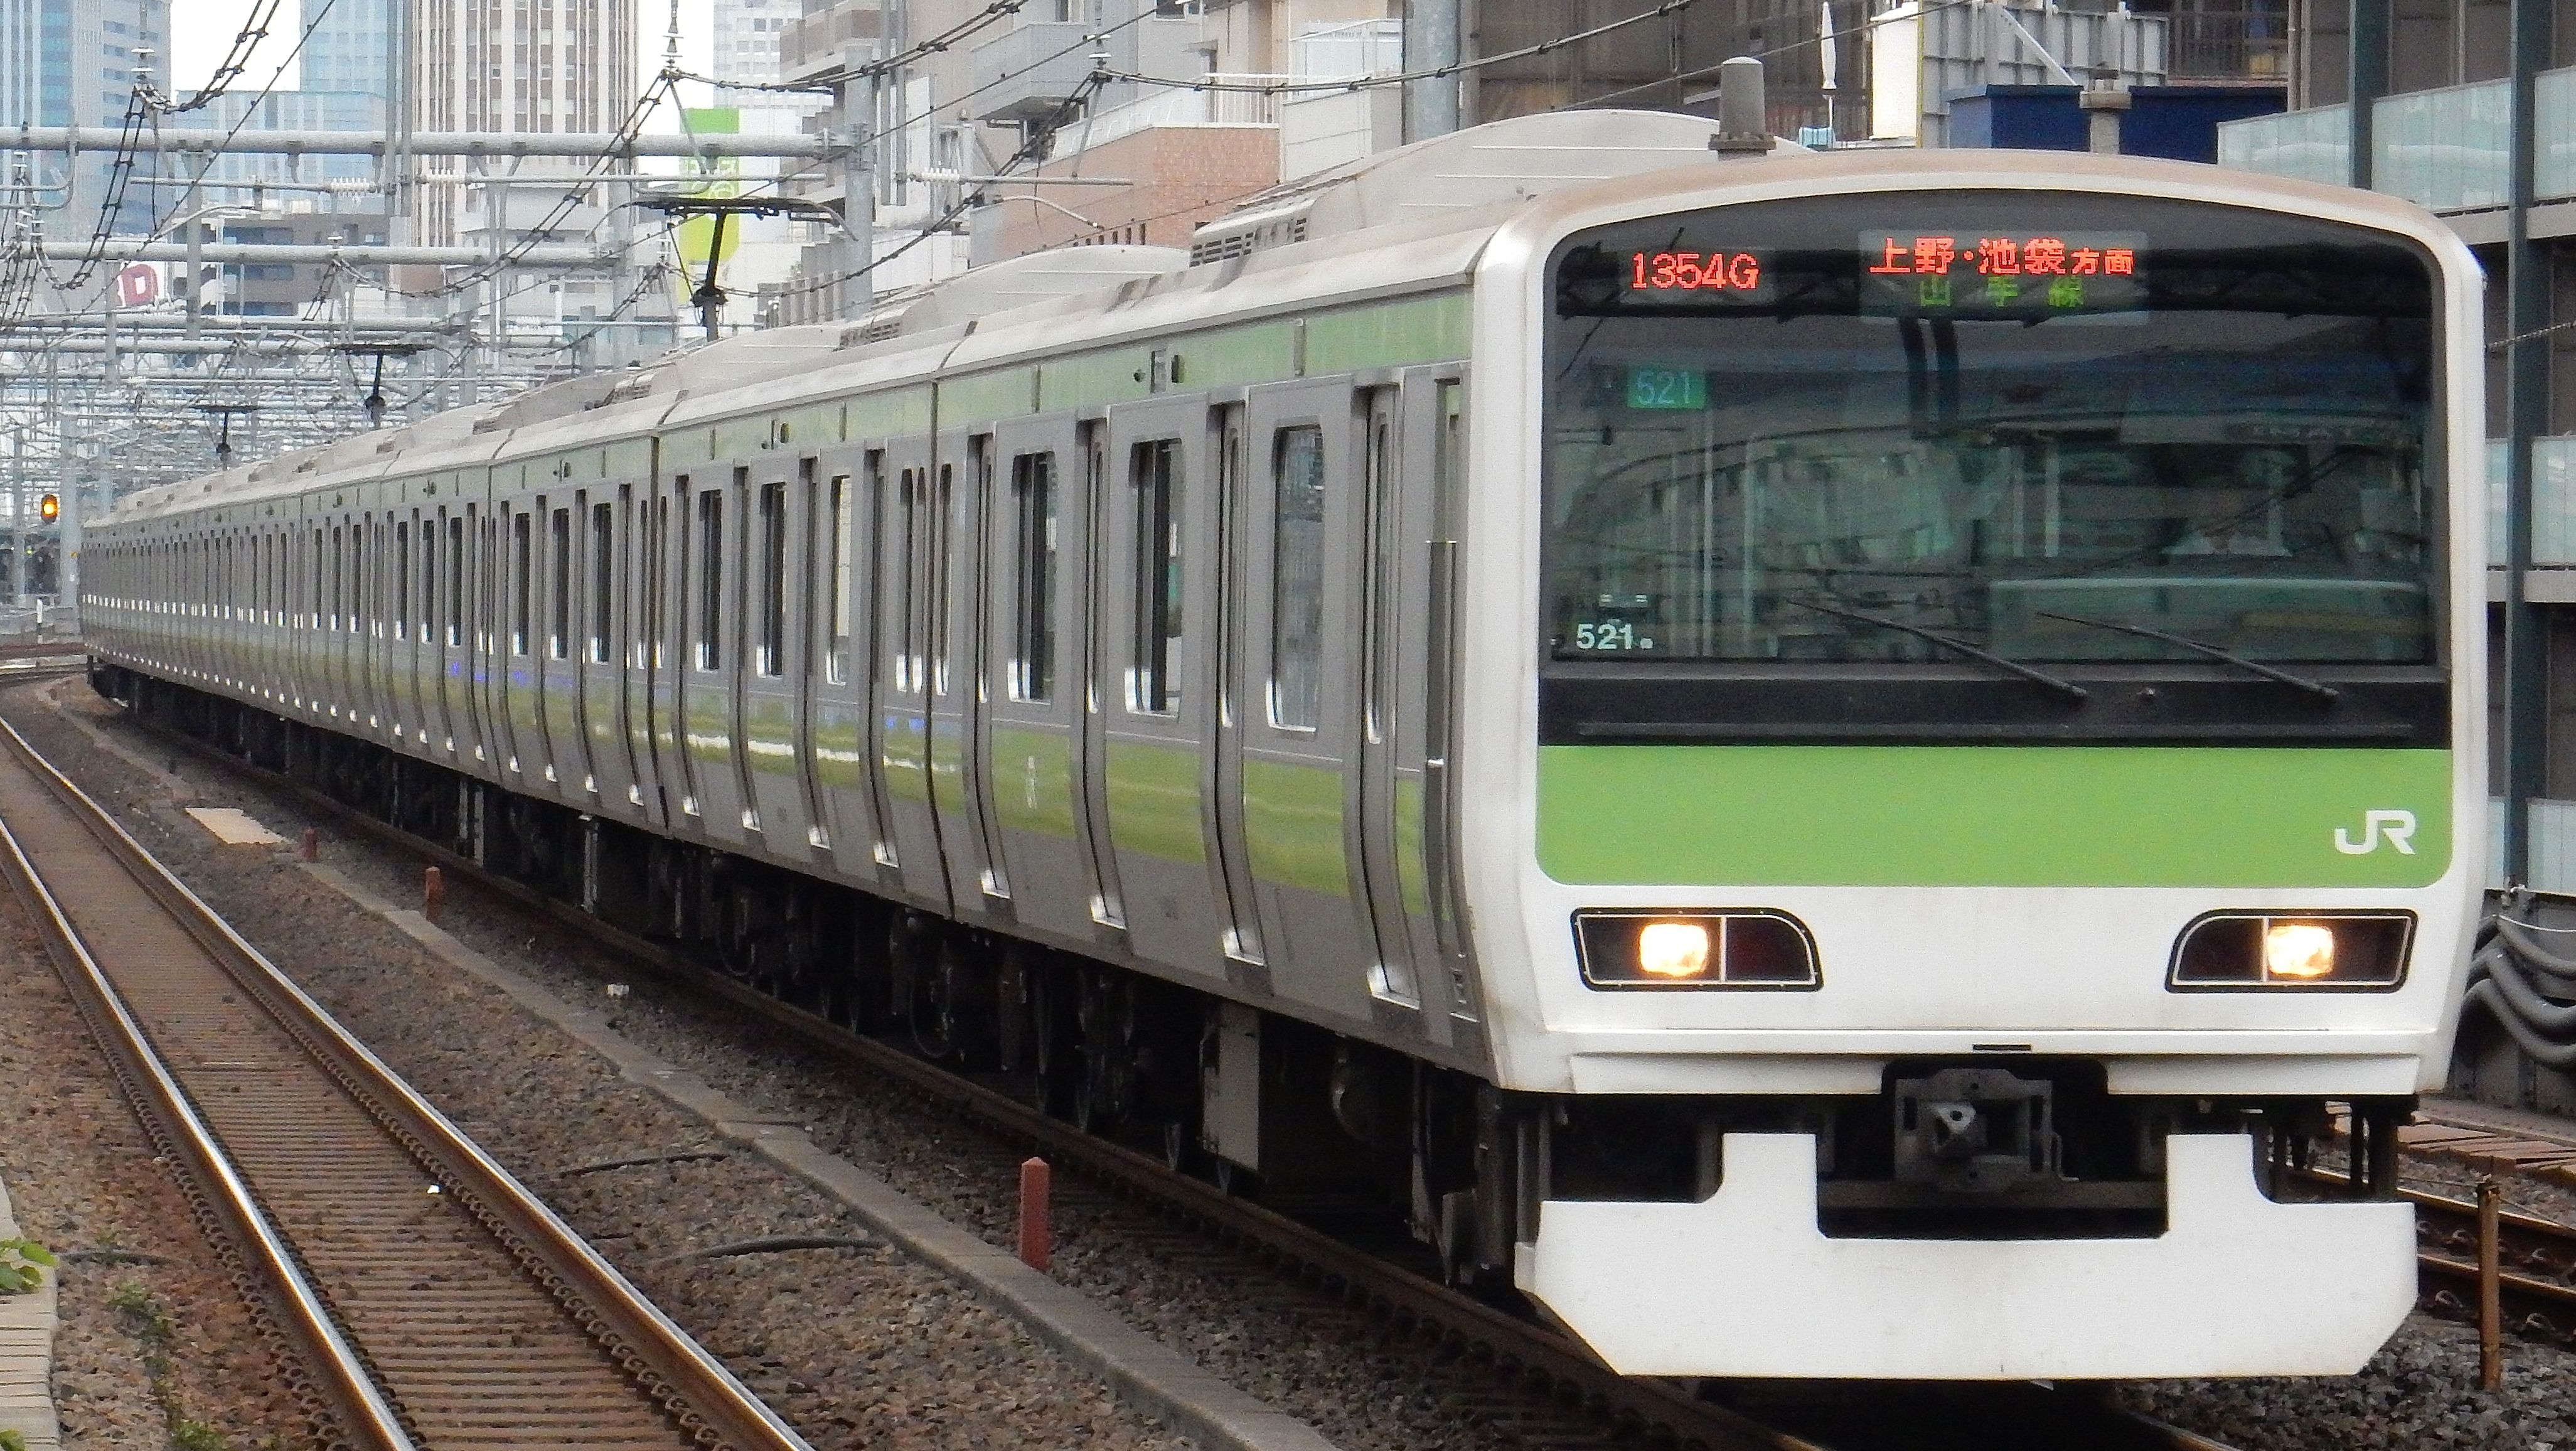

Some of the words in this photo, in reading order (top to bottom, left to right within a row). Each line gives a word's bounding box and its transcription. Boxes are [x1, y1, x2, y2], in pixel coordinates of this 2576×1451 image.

[1632, 252, 1760, 290] 1354G
[1637, 370, 1691, 405] 521
[1576, 623, 1633, 650] 521
[2334, 809, 2417, 855] JR
